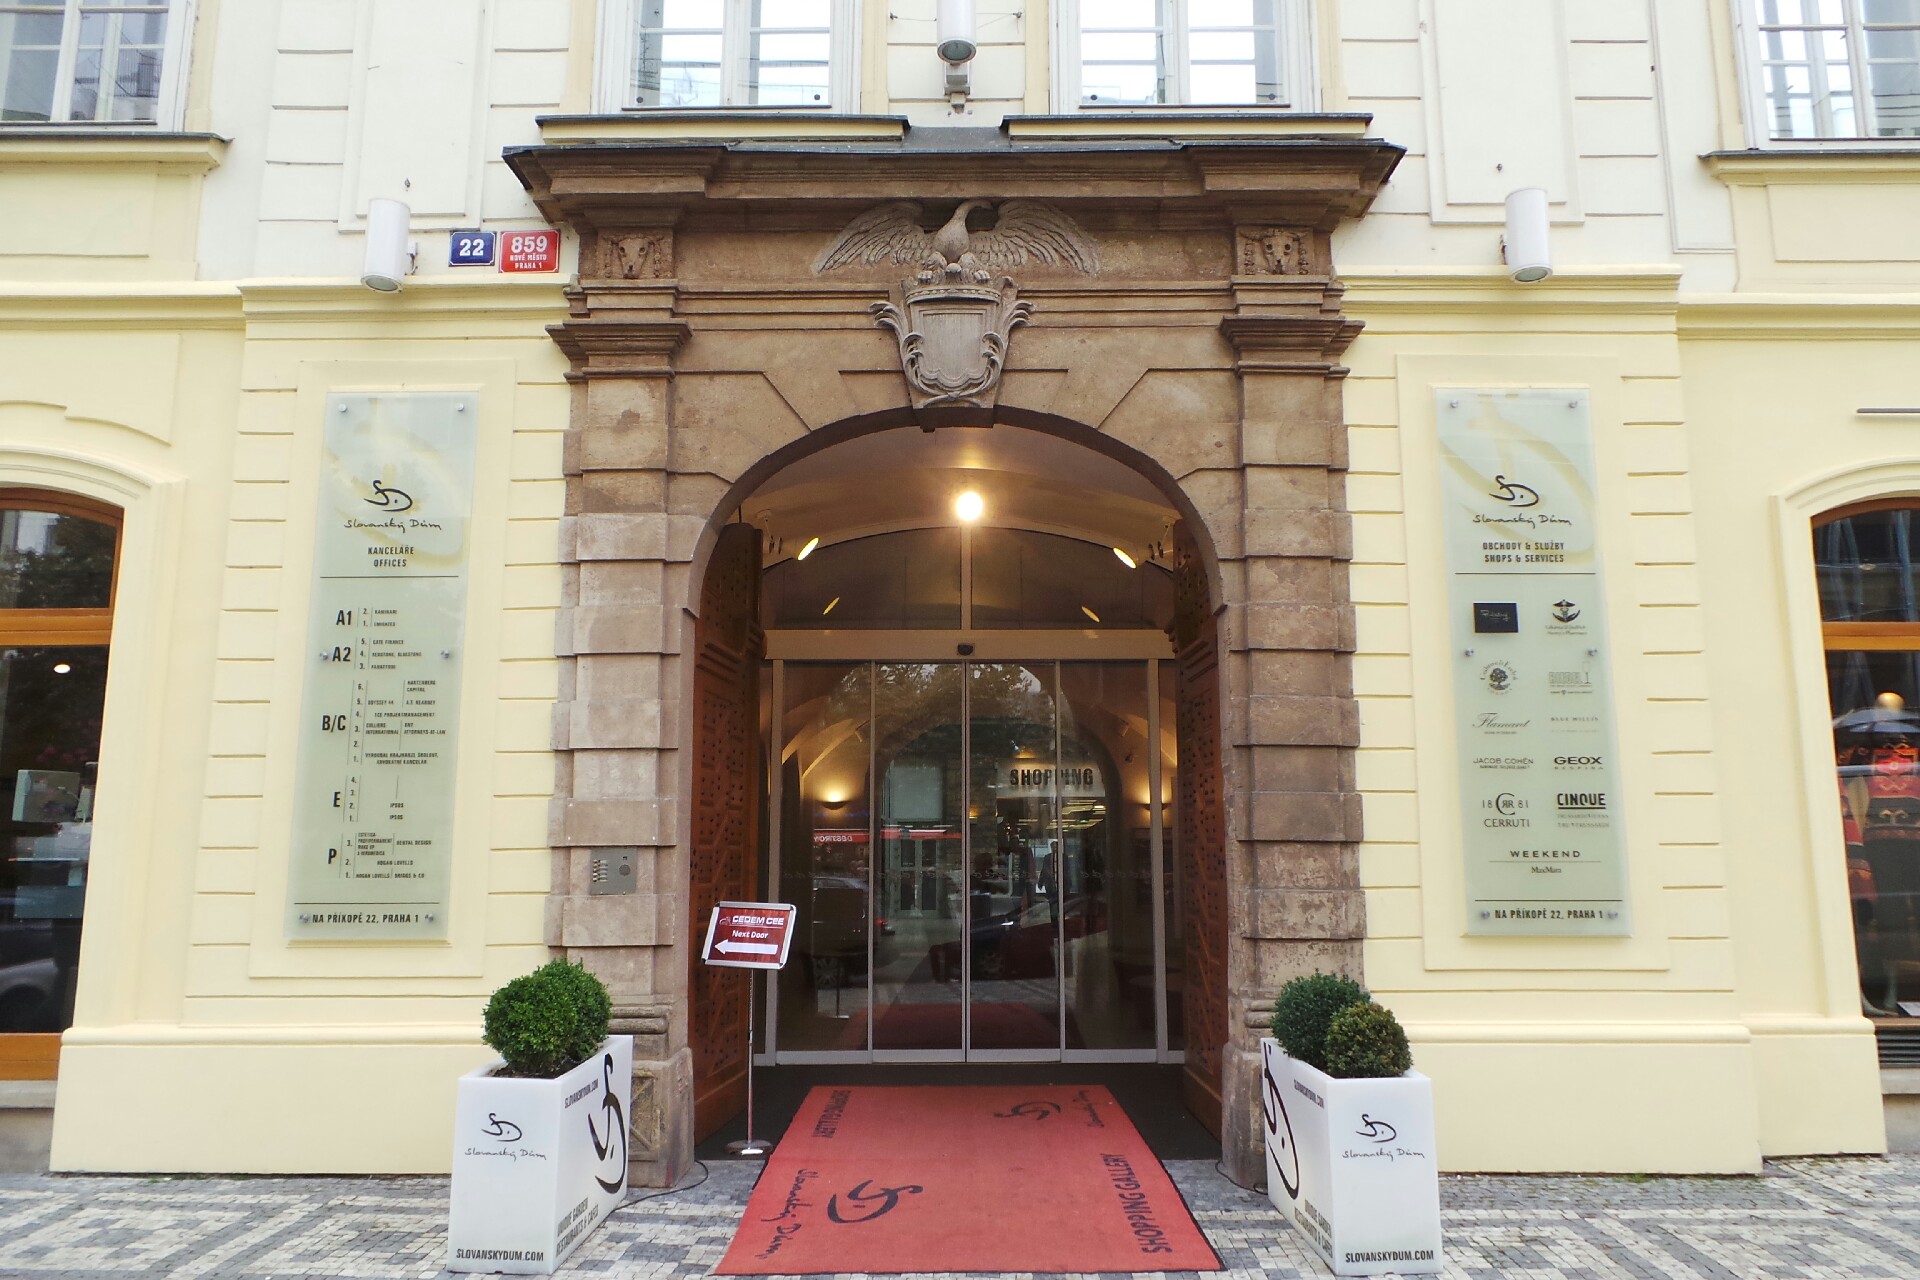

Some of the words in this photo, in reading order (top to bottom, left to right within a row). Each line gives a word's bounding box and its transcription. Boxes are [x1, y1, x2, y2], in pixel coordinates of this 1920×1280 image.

[460, 239, 484, 256] 22
[511, 235, 548, 253] 859
[510, 253, 525, 261] NOVÉ
[527, 253, 547, 261] MĚSTO
[1483, 542, 1521, 550] OBCHODY
[1525, 542, 1531, 550] &
[1535, 540, 1564, 550] SLUŽBY
[373, 559, 407, 567] OFFICES
[1485, 555, 1512, 563] SHOPS
[1516, 555, 1521, 563] &
[1525, 555, 1564, 563] SERVICES
[336, 610, 352, 625] A1
[332, 646, 351, 662] A2
[322, 715, 346, 732] B/C
[1472, 713, 1530, 728] Flamant
[1554, 757, 1603, 765] GEOX
[333, 792, 341, 807] E
[1557, 793, 1606, 806] CINQUE
[1484, 818, 1530, 828] CERRUTI
[328, 849, 337, 864] P
[313, 914, 324, 923] NA
[328, 912, 363, 923] PŘÍKOPĚ
[383, 914, 411, 923] PRAHA
[415, 914, 419, 923] 1
[1495, 910, 1507, 918] NA
[1511, 908, 1547, 918] PŘÍKOPĚ
[1568, 910, 1595, 918] PRAHA
[1599, 910, 1603, 918] 1
[766, 917, 784, 925] CEE
[732, 930, 750, 938] Next
[751, 931, 768, 939] Door
[1100, 1153, 1141, 1191] GALLERY
[1118, 1192, 1172, 1253] SHOPPING
[456, 1248, 544, 1262] SLOVANSKYDUM.COM
[1345, 1250, 1434, 1263] SLOVANSKYDUM.COM
